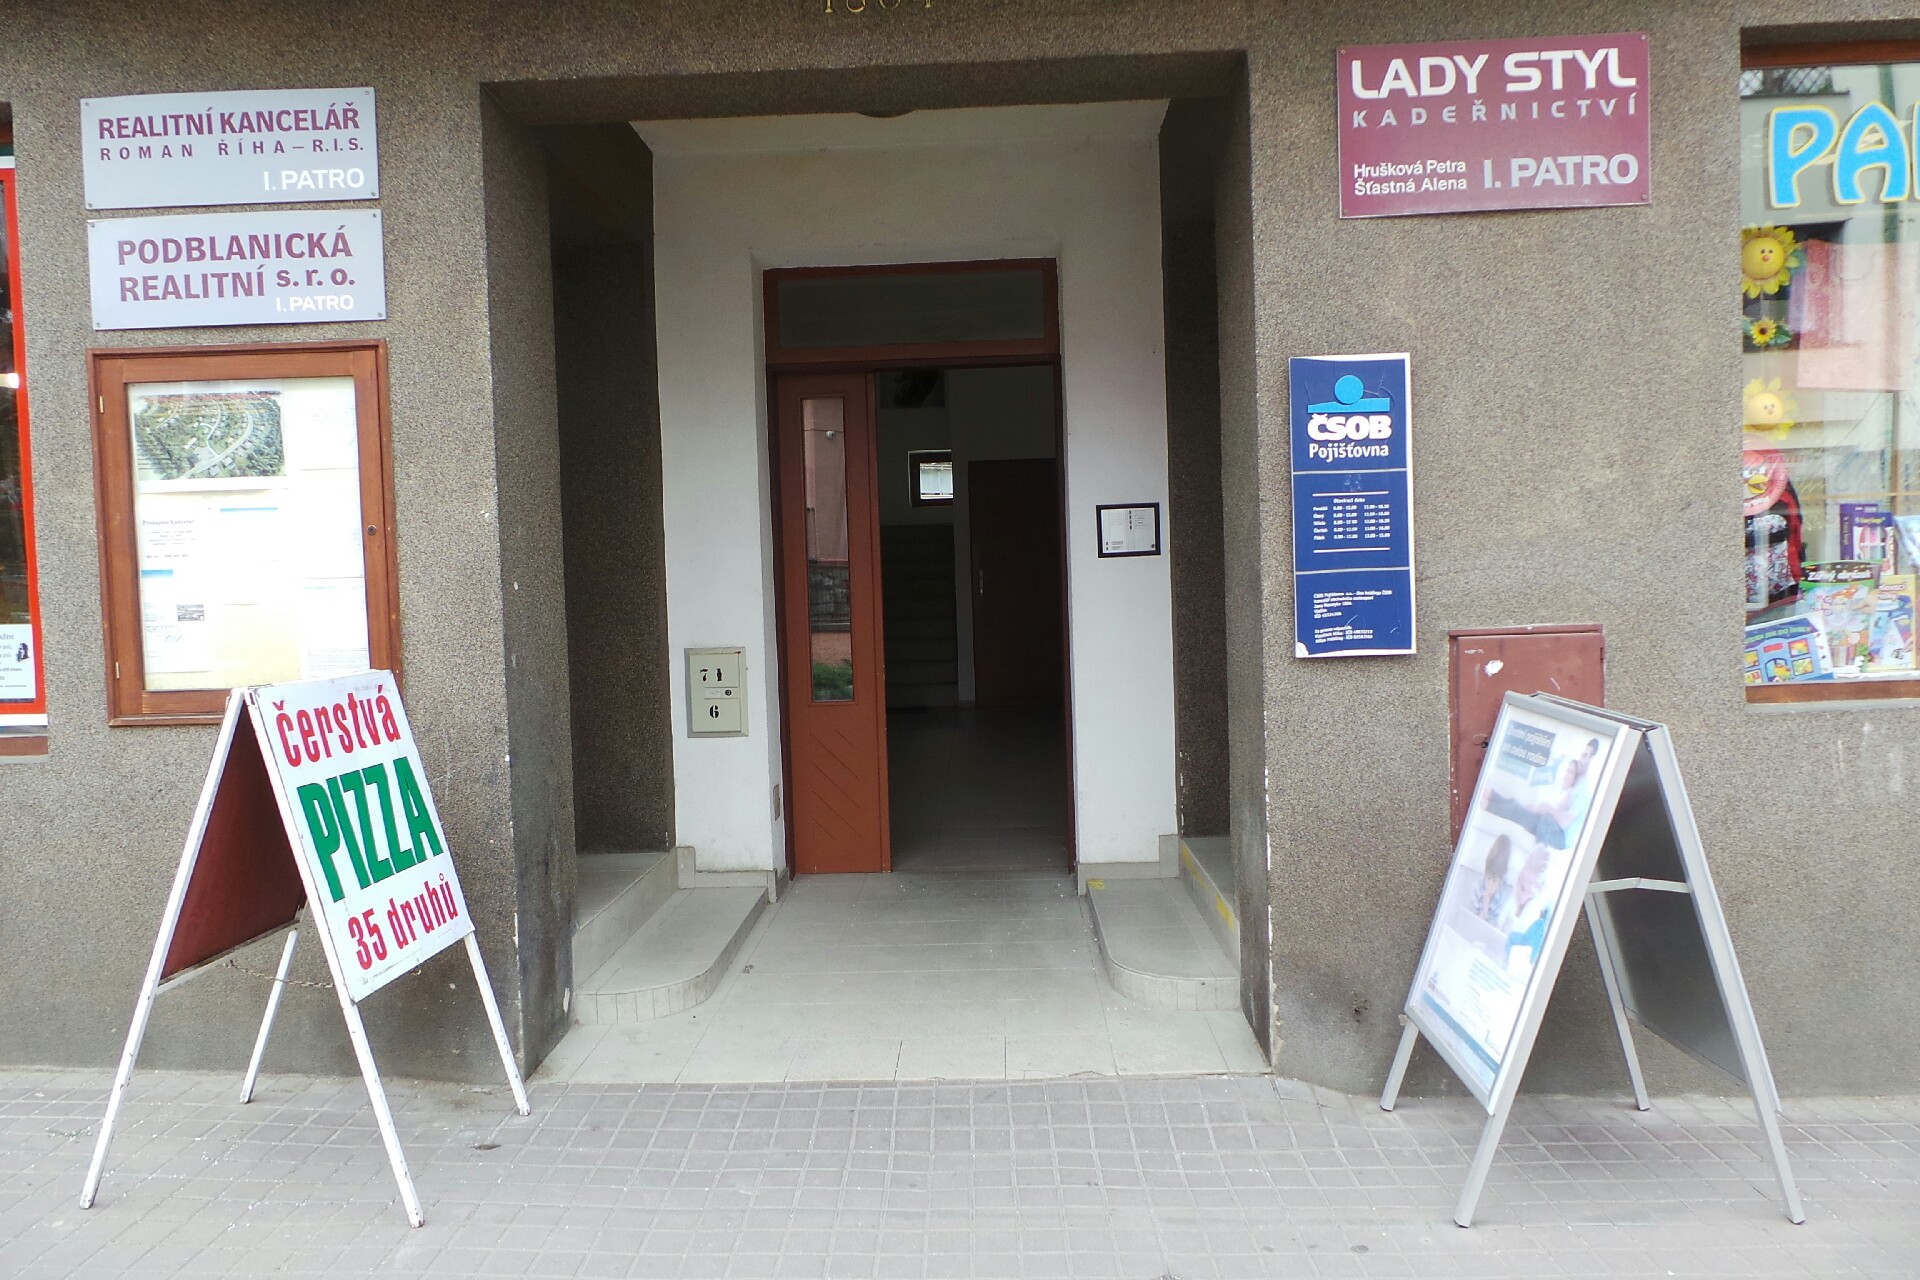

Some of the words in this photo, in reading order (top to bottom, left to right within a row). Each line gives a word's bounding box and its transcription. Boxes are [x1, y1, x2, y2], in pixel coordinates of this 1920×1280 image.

[1351, 54, 1489, 99] LADY
[1504, 47, 1637, 92] STYL
[99, 107, 214, 140] REALITNÍ
[219, 102, 360, 134] KANCELÁŘ
[1352, 92, 1637, 129] KADEŘNICTVÍ
[100, 143, 194, 161] ROMAN
[217, 138, 285, 157] ŘÍHA
[312, 137, 364, 153] R.I.S.
[1767, 99, 1920, 210] PA
[281, 167, 365, 190] PATRO
[1353, 160, 1423, 179] Hrušková
[1426, 159, 1466, 173] Petra
[1354, 178, 1415, 196] Šťastná
[1420, 177, 1467, 192] Alena
[1483, 159, 1501, 189] I.
[1510, 153, 1639, 188] PATRO
[117, 225, 353, 265] PODBLANICKÁ
[120, 264, 265, 302] REALITNÍ
[289, 294, 354, 312] PATRO
[1307, 413, 1392, 441] ČSOB
[1309, 442, 1389, 463] Pojišťovna
[272, 683, 402, 768] čerstvá
[709, 704, 720, 719] 6
[296, 756, 444, 904] PIZZA
[348, 907, 388, 971] 35
[387, 872, 459, 951] druhů
